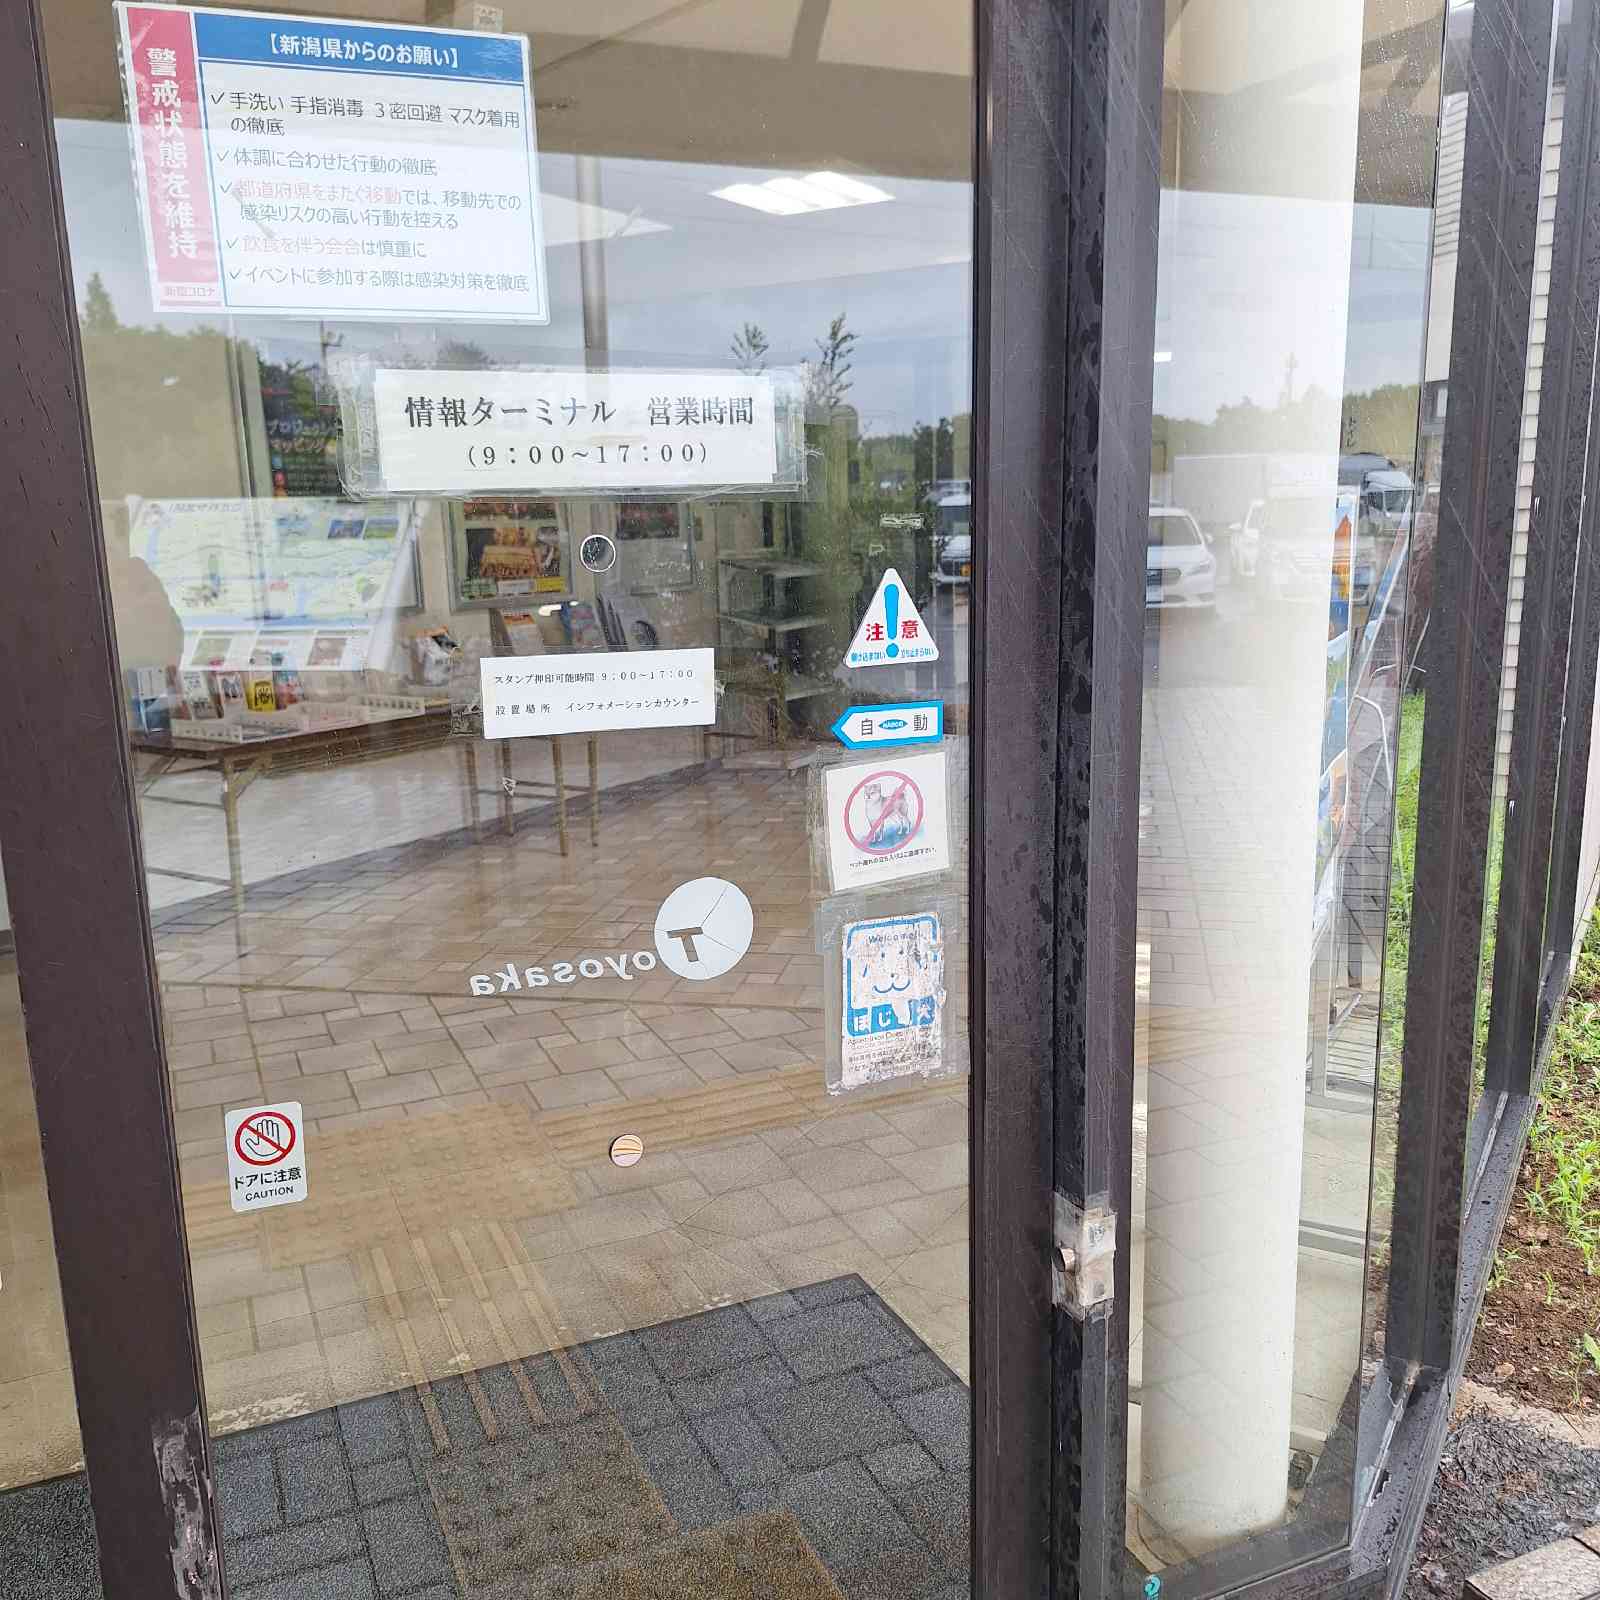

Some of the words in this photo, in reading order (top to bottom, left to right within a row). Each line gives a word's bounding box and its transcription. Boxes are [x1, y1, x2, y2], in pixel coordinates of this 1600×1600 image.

[230, 91, 284, 111] 手洗い
[291, 95, 364, 119] 手指消毒
[450, 107, 520, 129] マスク着用
[231, 118, 285, 137] の徹底
[146, 47, 198, 258] 警戒状態を維持
[233, 149, 437, 176] 体調に合わせた行動の徹底
[240, 204, 459, 230] 感染リスクの高い行動を控える
[246, 270, 530, 292] イベントに参加する際は感染対策を徹底
[405, 396, 616, 428] 情報ターミナル
[647, 396, 754, 426] 営業時間
[495, 672, 595, 685] スタンプ押印可能時間
[566, 697, 700, 713] インフォメーションカウンター
[234, 1167, 302, 1190] ドアに注意
[245, 1186, 294, 1201] CAUTION
